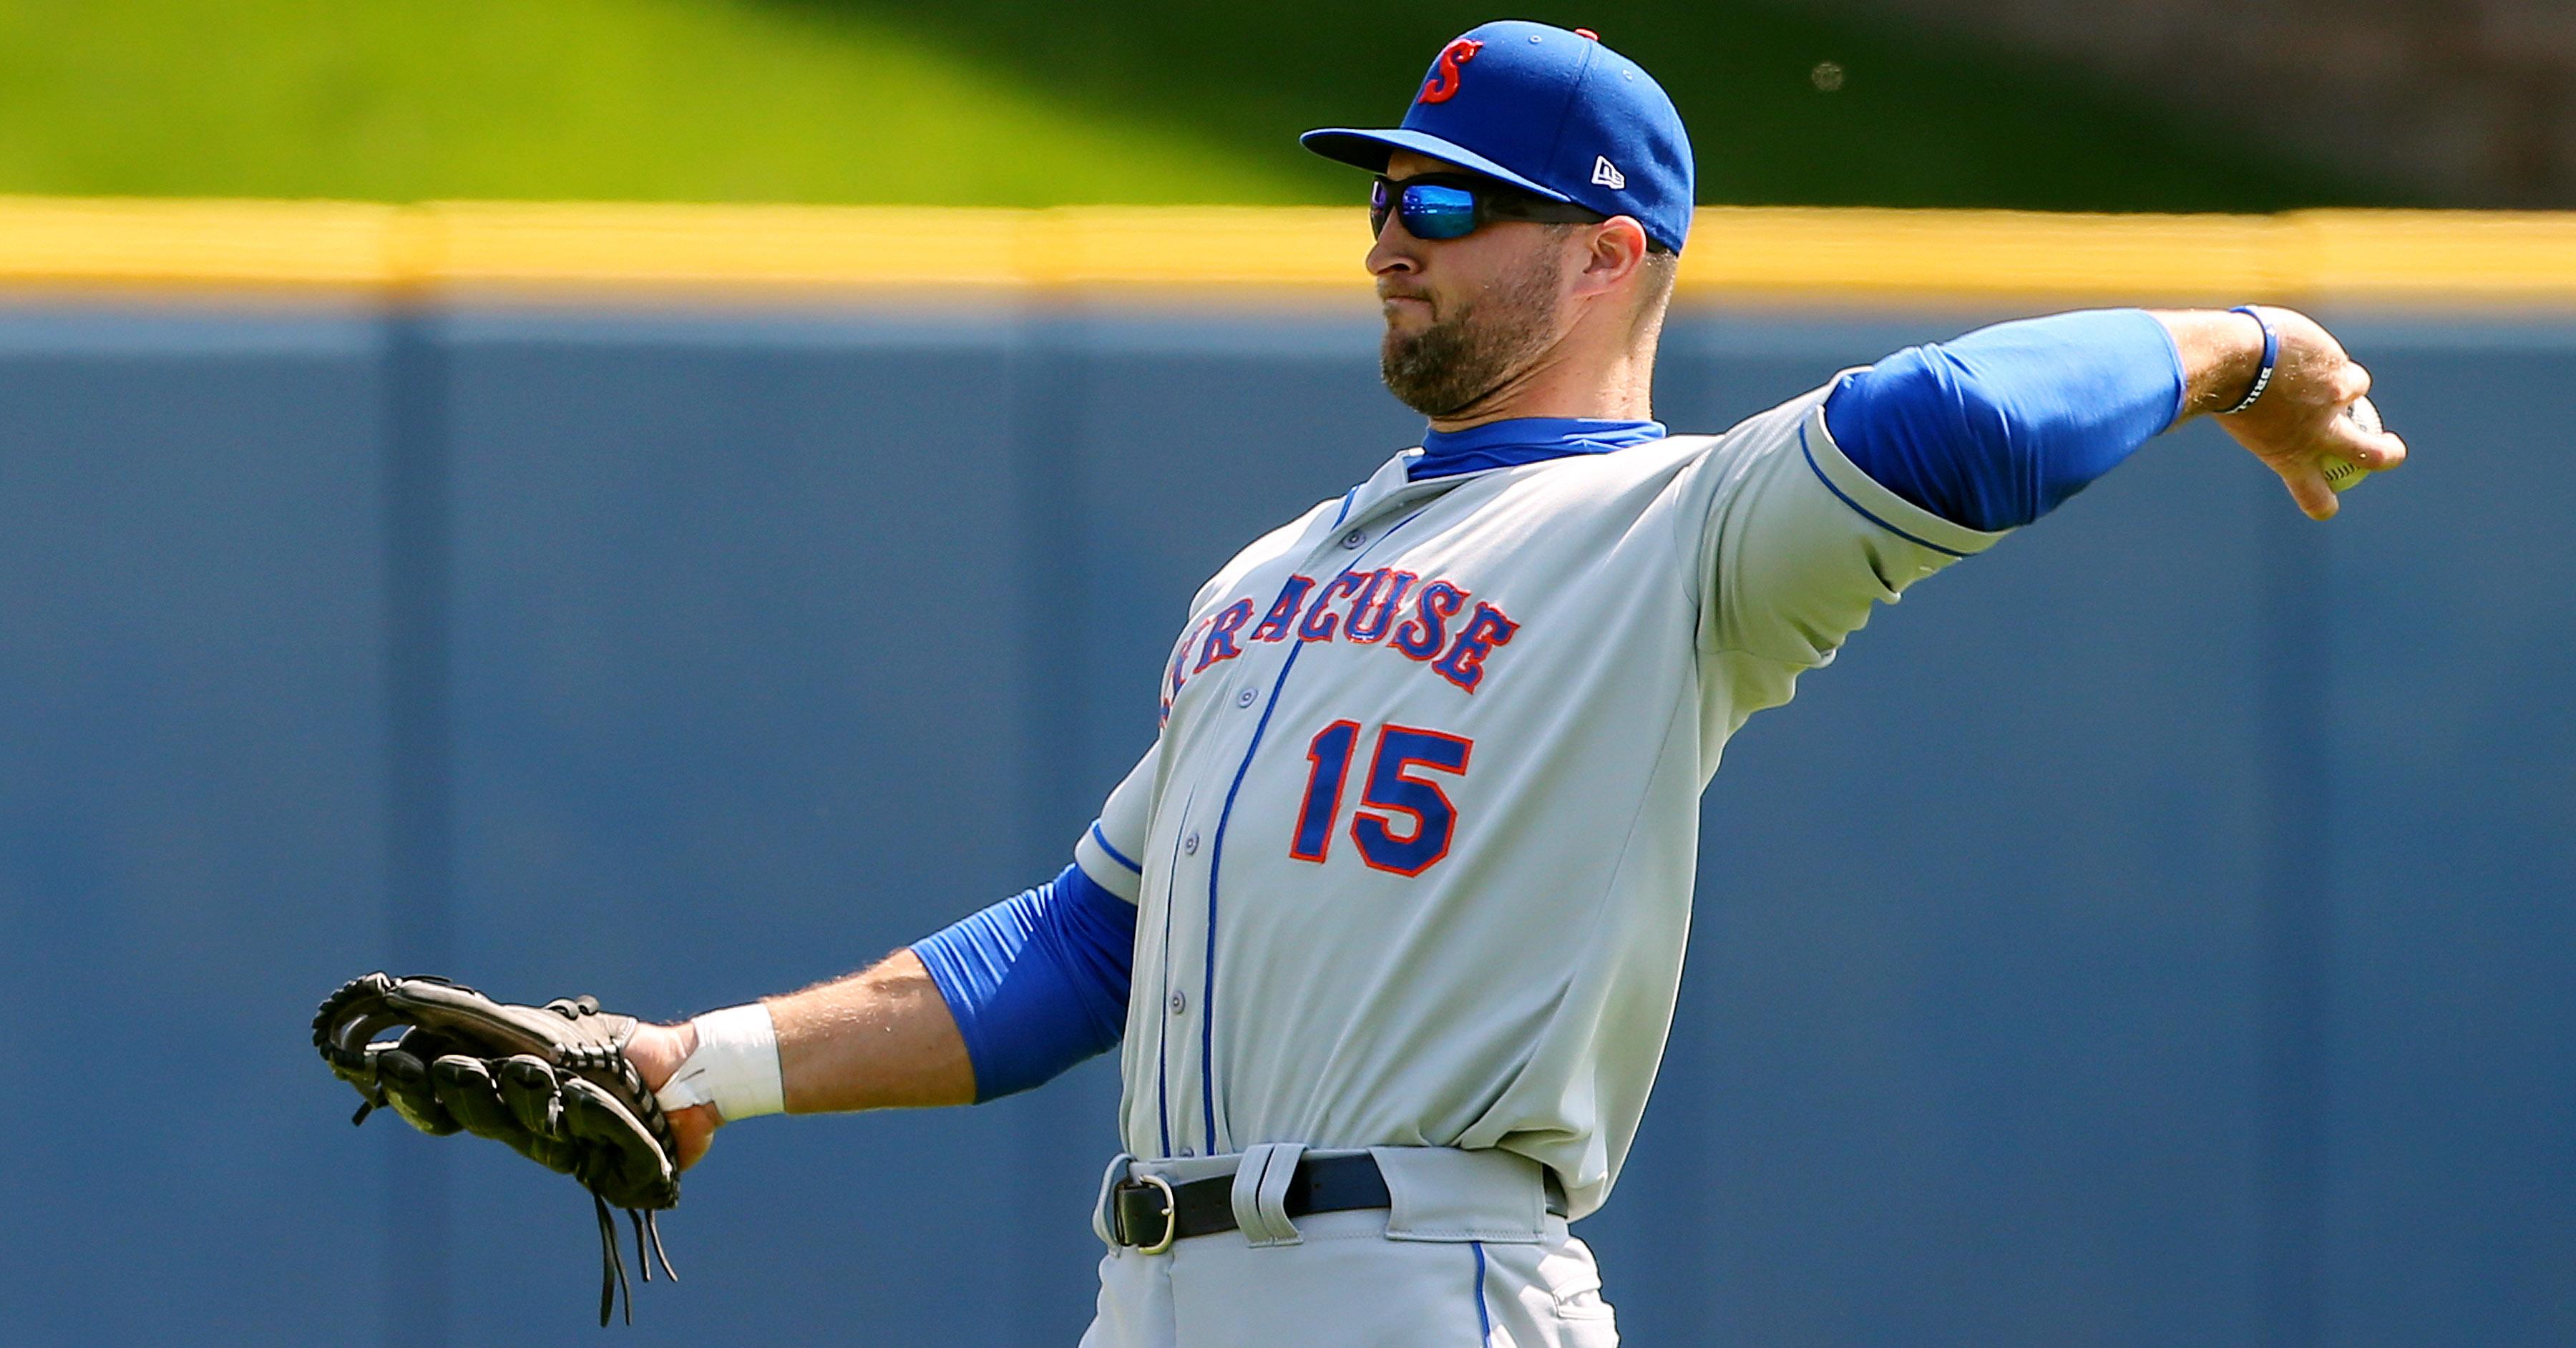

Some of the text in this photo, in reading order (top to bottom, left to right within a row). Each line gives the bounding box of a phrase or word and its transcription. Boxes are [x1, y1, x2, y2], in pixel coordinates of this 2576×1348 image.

[1418, 38, 1484, 104] S
[1158, 567, 1521, 729] YRACUSE
[1288, 718, 1474, 878] 15
